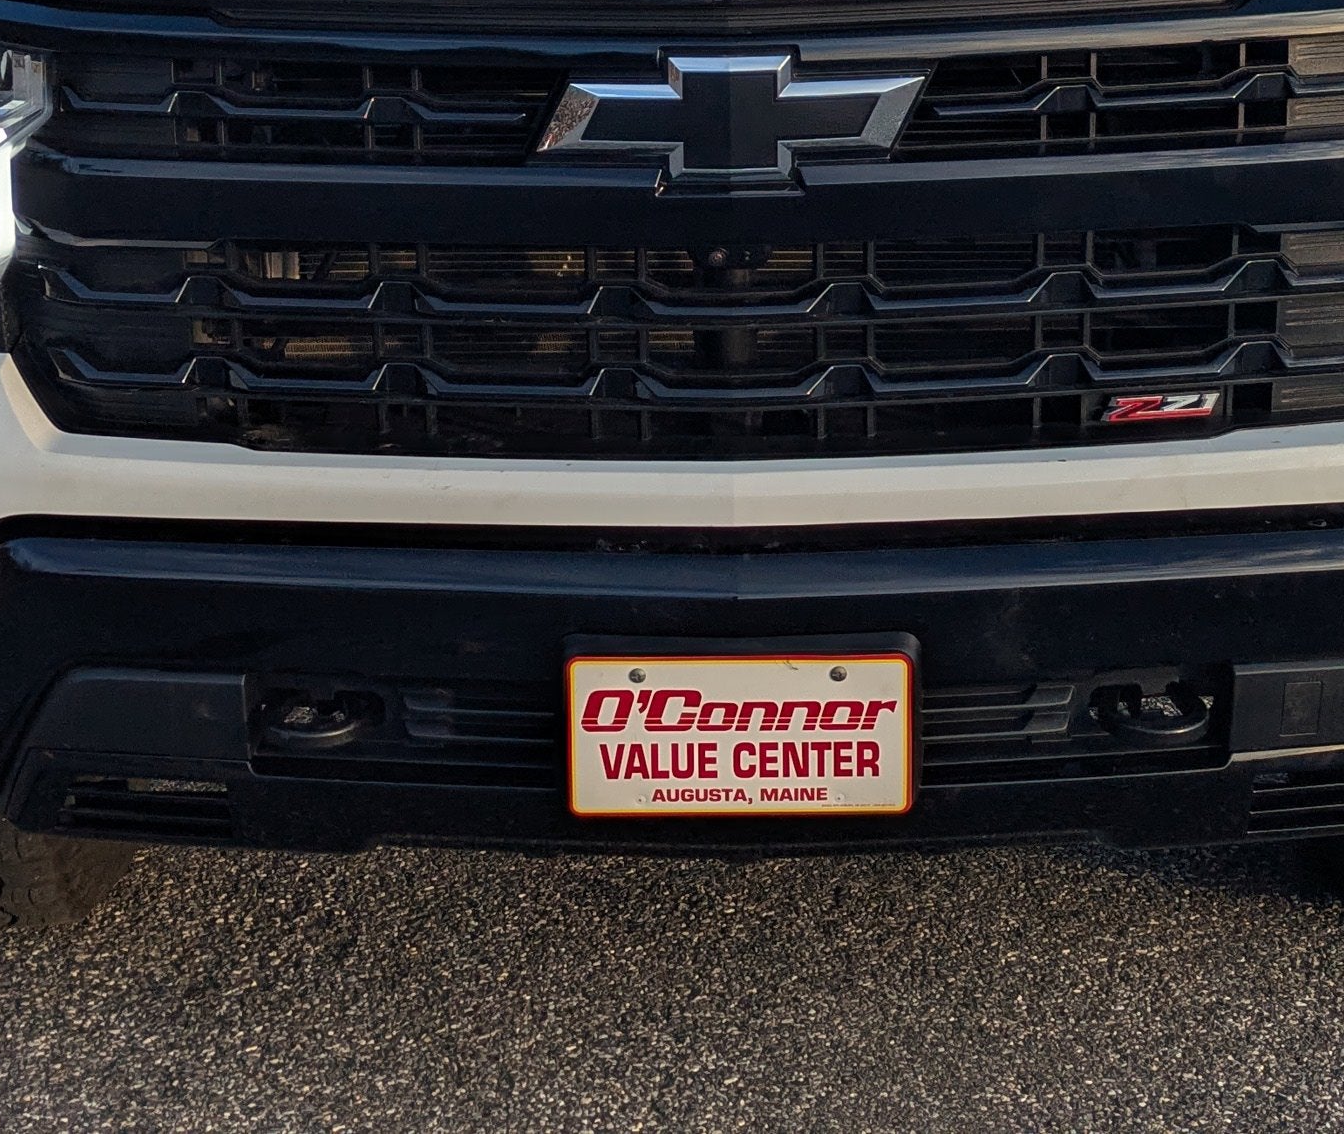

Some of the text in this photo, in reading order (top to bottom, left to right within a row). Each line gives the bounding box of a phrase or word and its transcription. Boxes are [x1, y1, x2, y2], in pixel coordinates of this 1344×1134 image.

[1103, 392, 1220, 422] Z71
[581, 689, 898, 732] O'Connor
[599, 740, 880, 780] VALUE CENTER
[651, 787, 828, 804] AUGUSTA, MAINE
